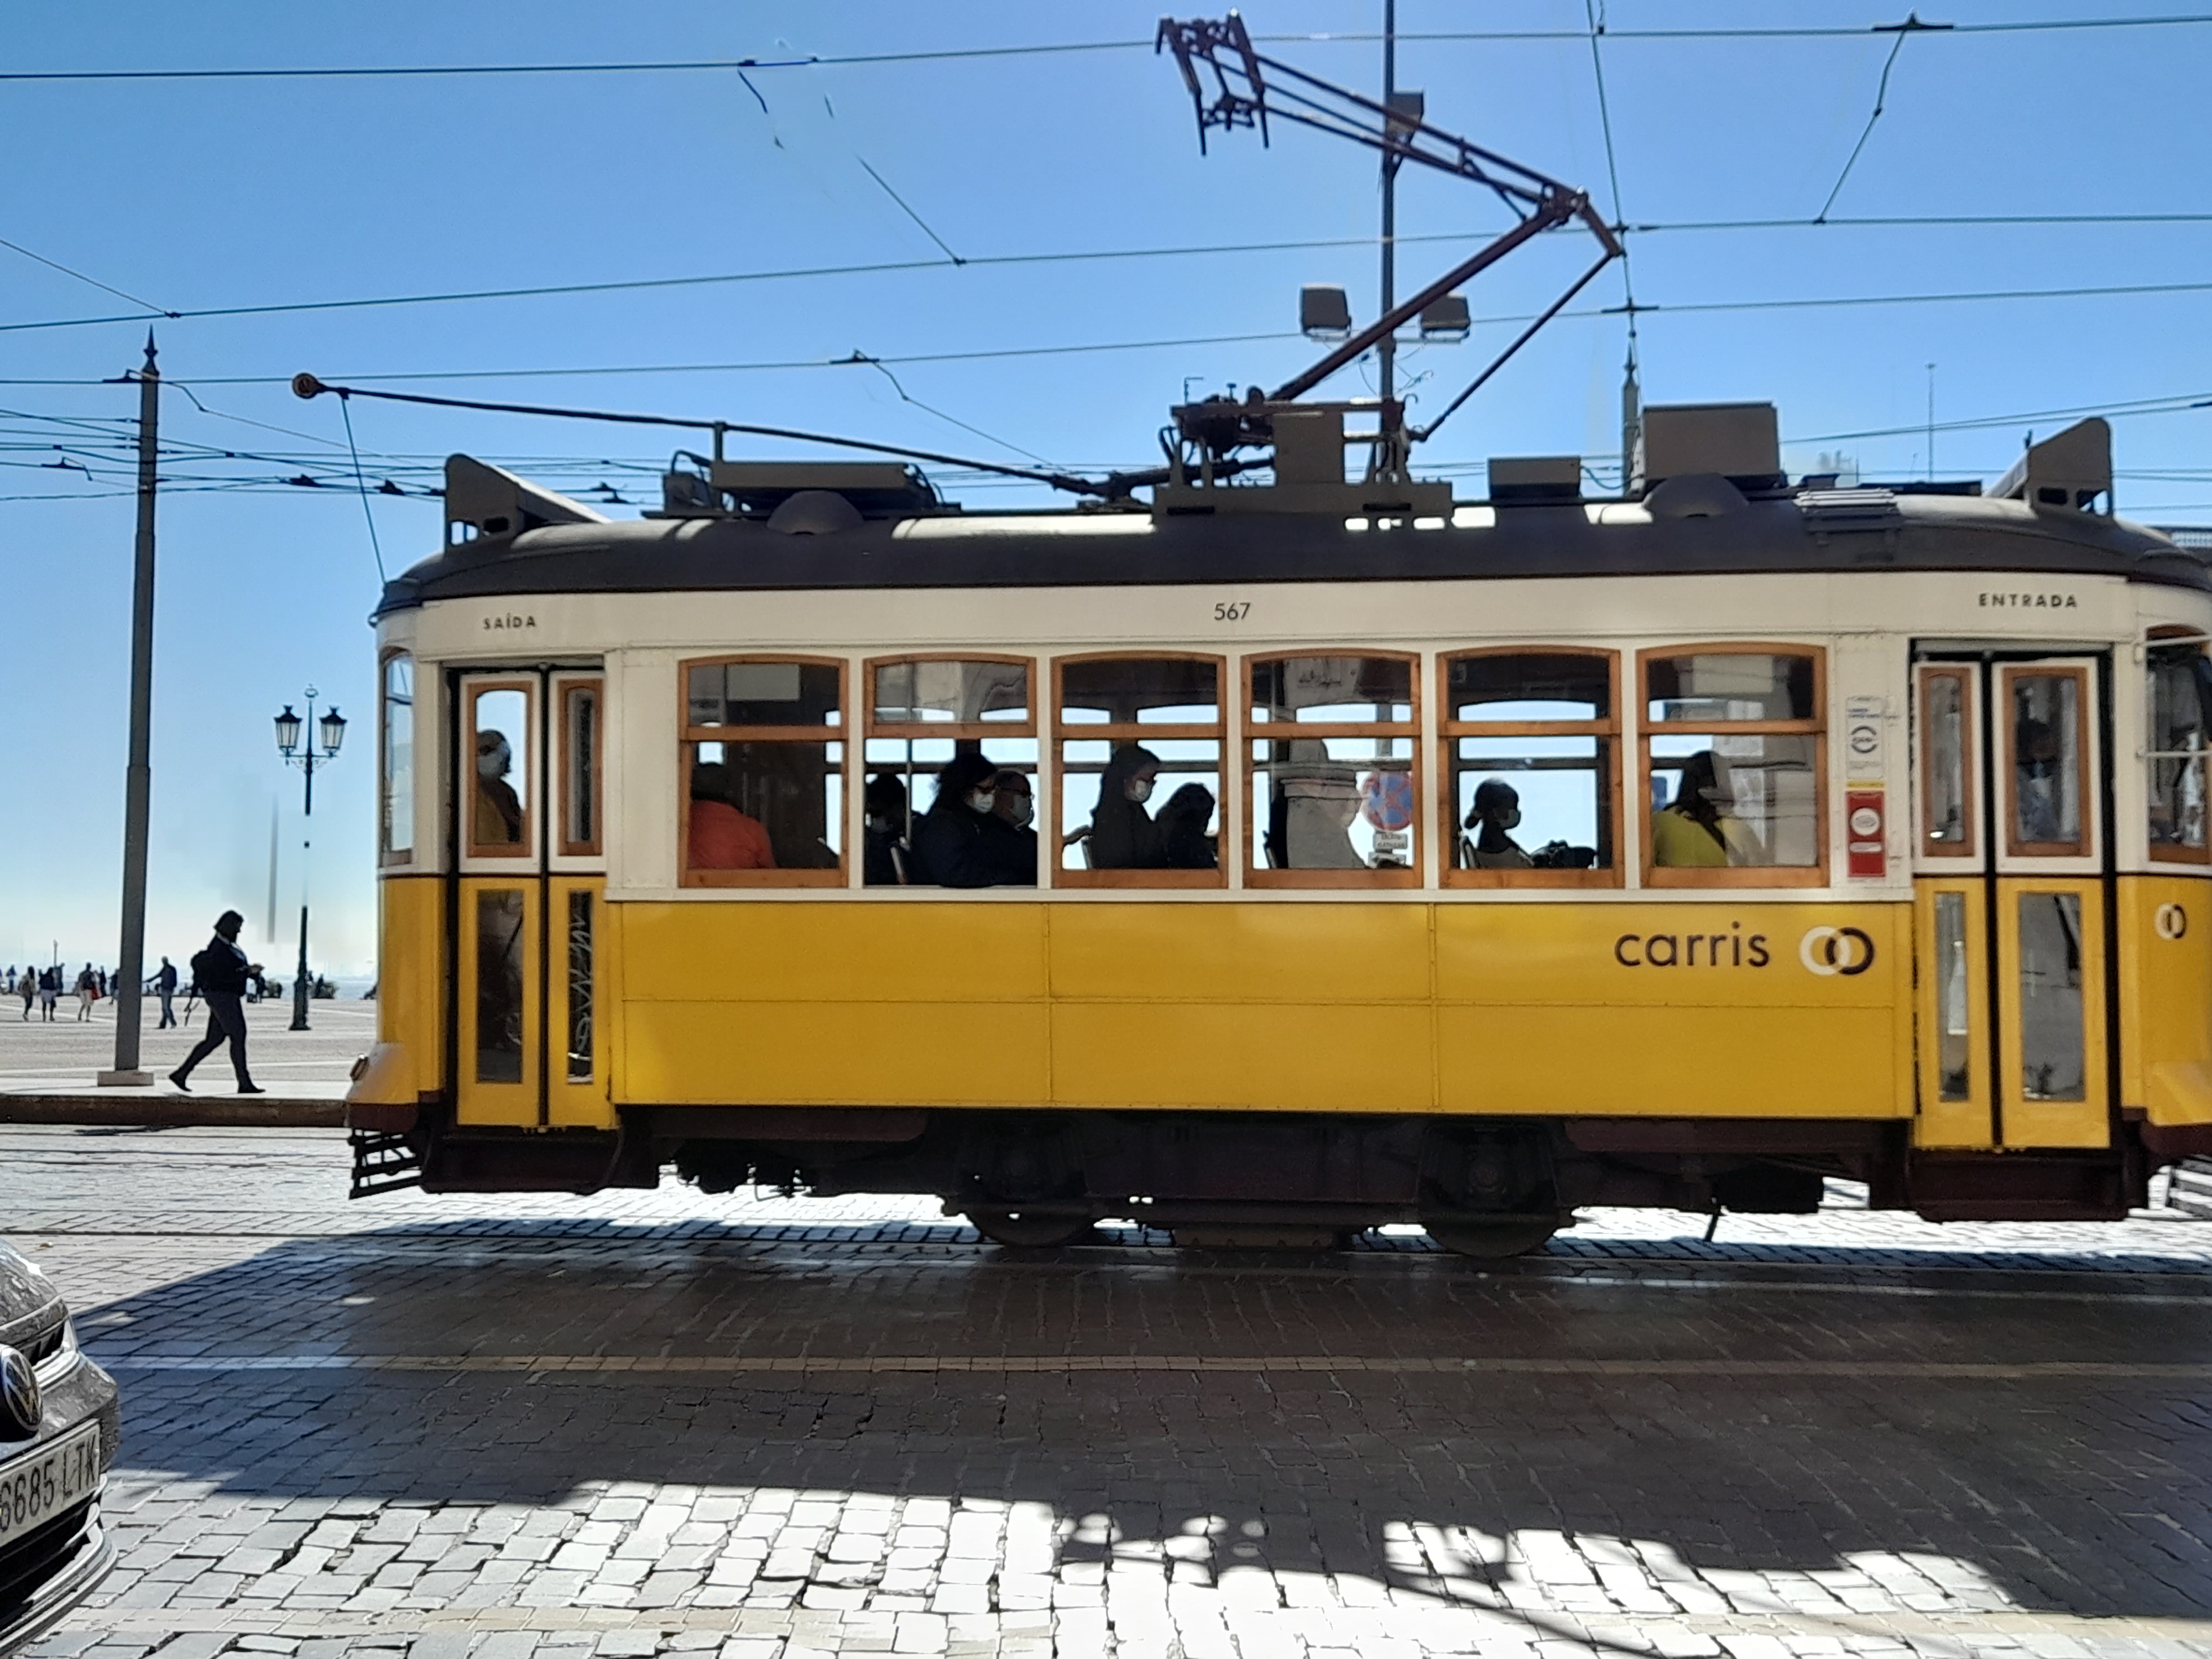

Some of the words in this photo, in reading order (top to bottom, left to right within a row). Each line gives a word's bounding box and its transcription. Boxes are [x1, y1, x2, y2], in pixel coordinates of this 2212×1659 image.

[1979, 593, 2077, 607] ENTRADA
[1214, 602, 1250, 620] 567
[483, 612, 536, 630] SAÍDA
[1614, 921, 1770, 967] carris
